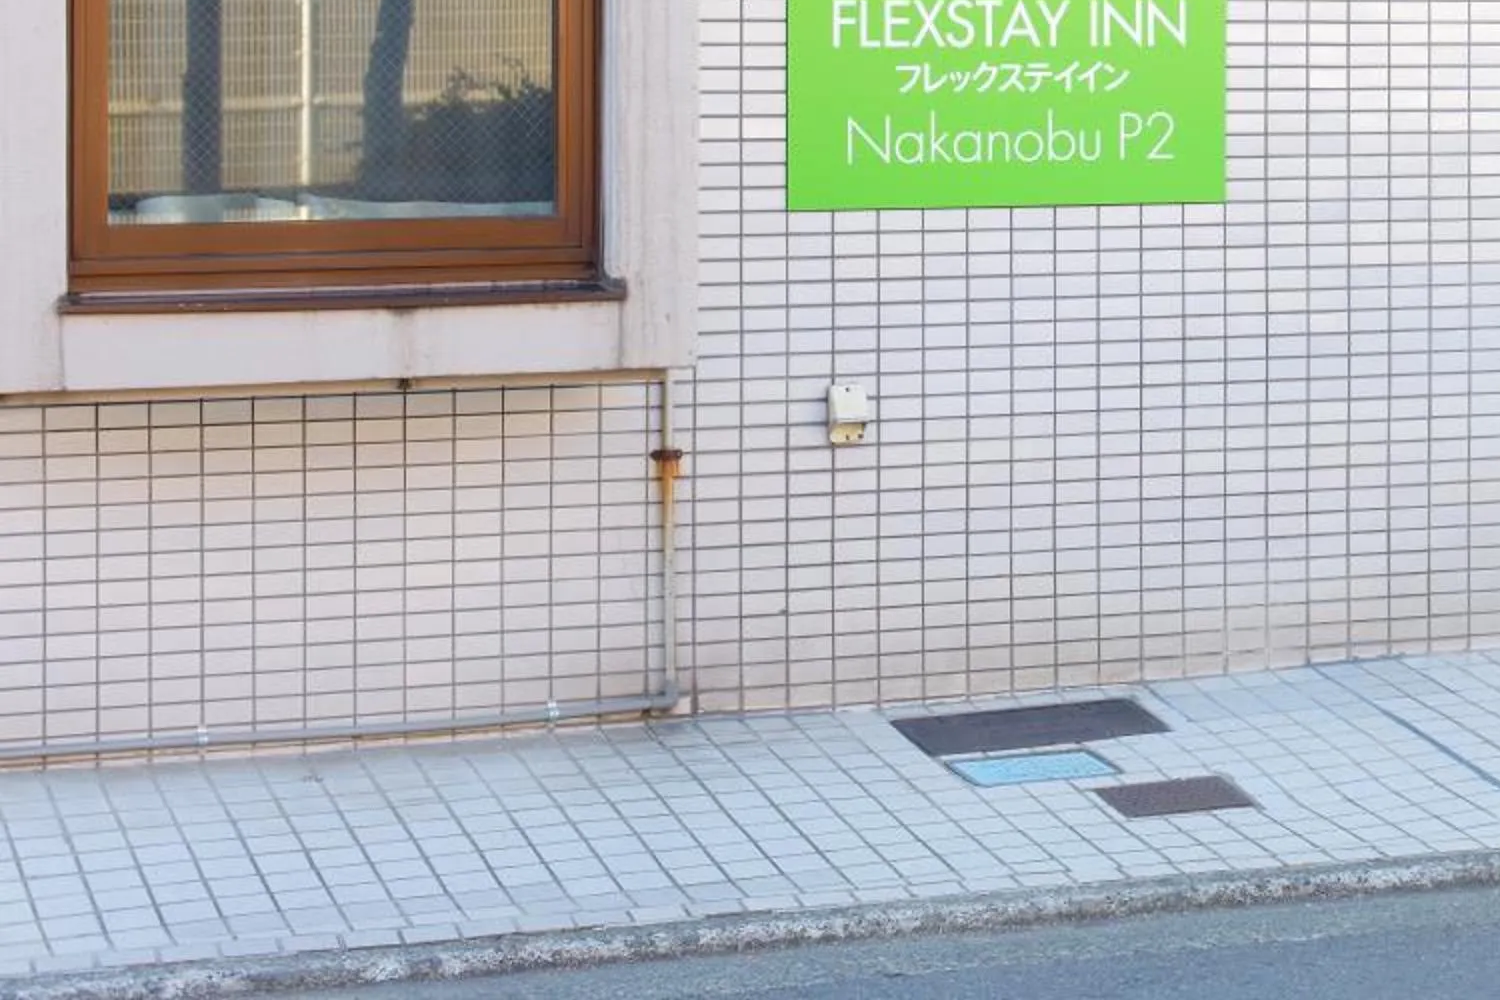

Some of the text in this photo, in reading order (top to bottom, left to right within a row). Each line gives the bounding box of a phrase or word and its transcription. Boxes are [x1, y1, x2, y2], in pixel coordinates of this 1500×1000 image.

[894, 60, 1130, 94] フレックステイイン
[846, 110, 1175, 164] Nakanobu P2
